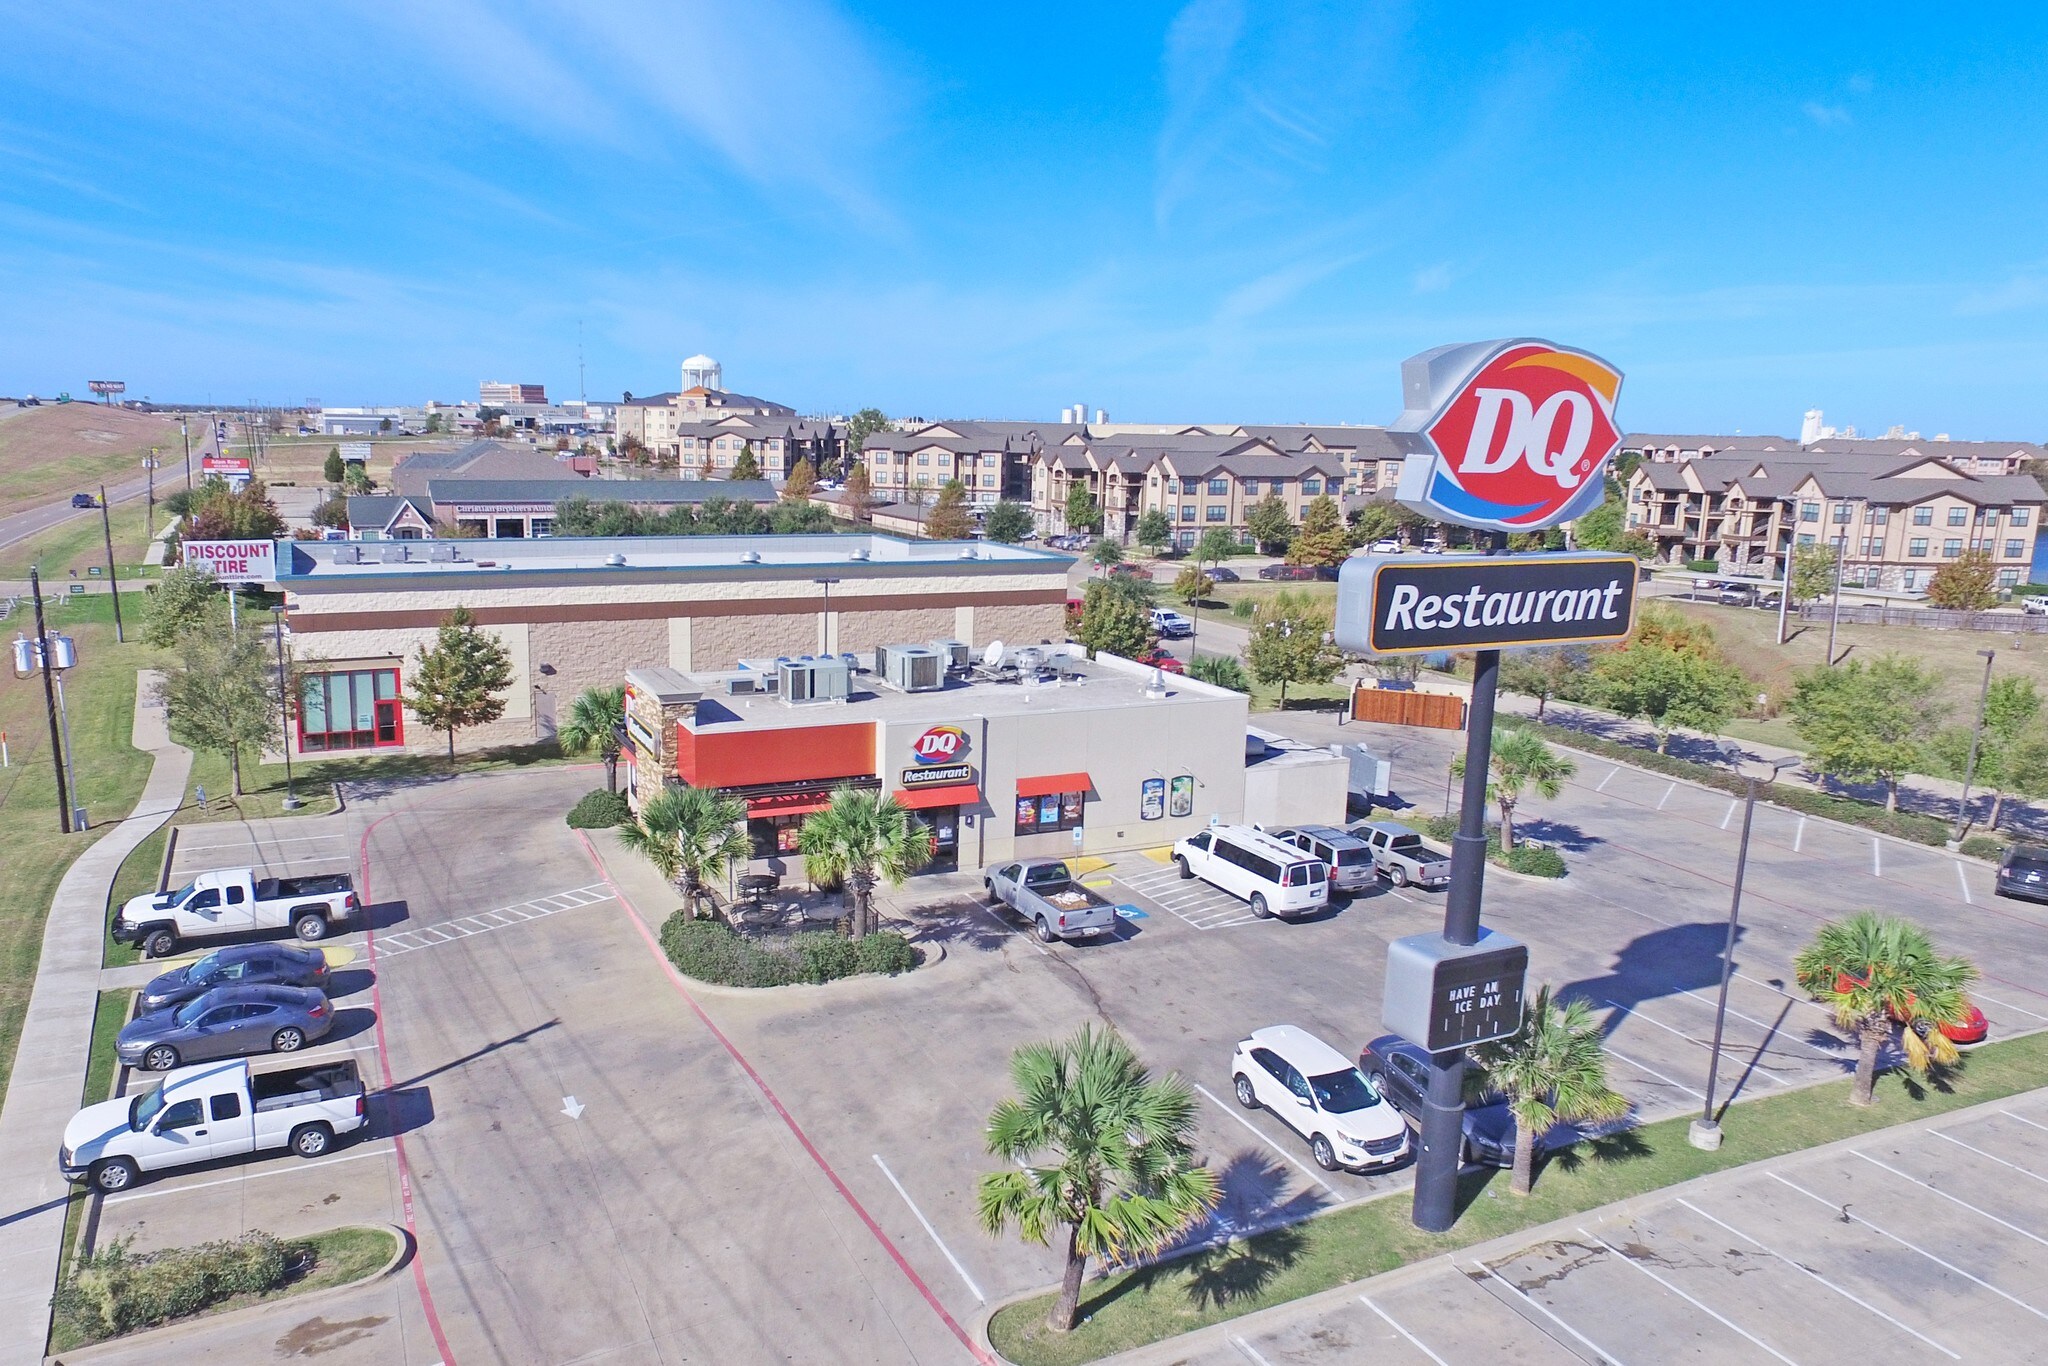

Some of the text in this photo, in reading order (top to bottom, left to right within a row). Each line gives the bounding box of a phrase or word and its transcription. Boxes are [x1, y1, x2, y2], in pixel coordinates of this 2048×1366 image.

[1458, 388, 1593, 488] DQ
[188, 544, 269, 559] DISCOUNT
[212, 560, 248, 573] TIRE
[1384, 580, 1623, 631] Restaurant
[921, 733, 957, 754] DQ
[903, 766, 969, 782] Restaurant
[1449, 981, 1499, 1002] HAVE AN
[1455, 1000, 1473, 1014] ICE
